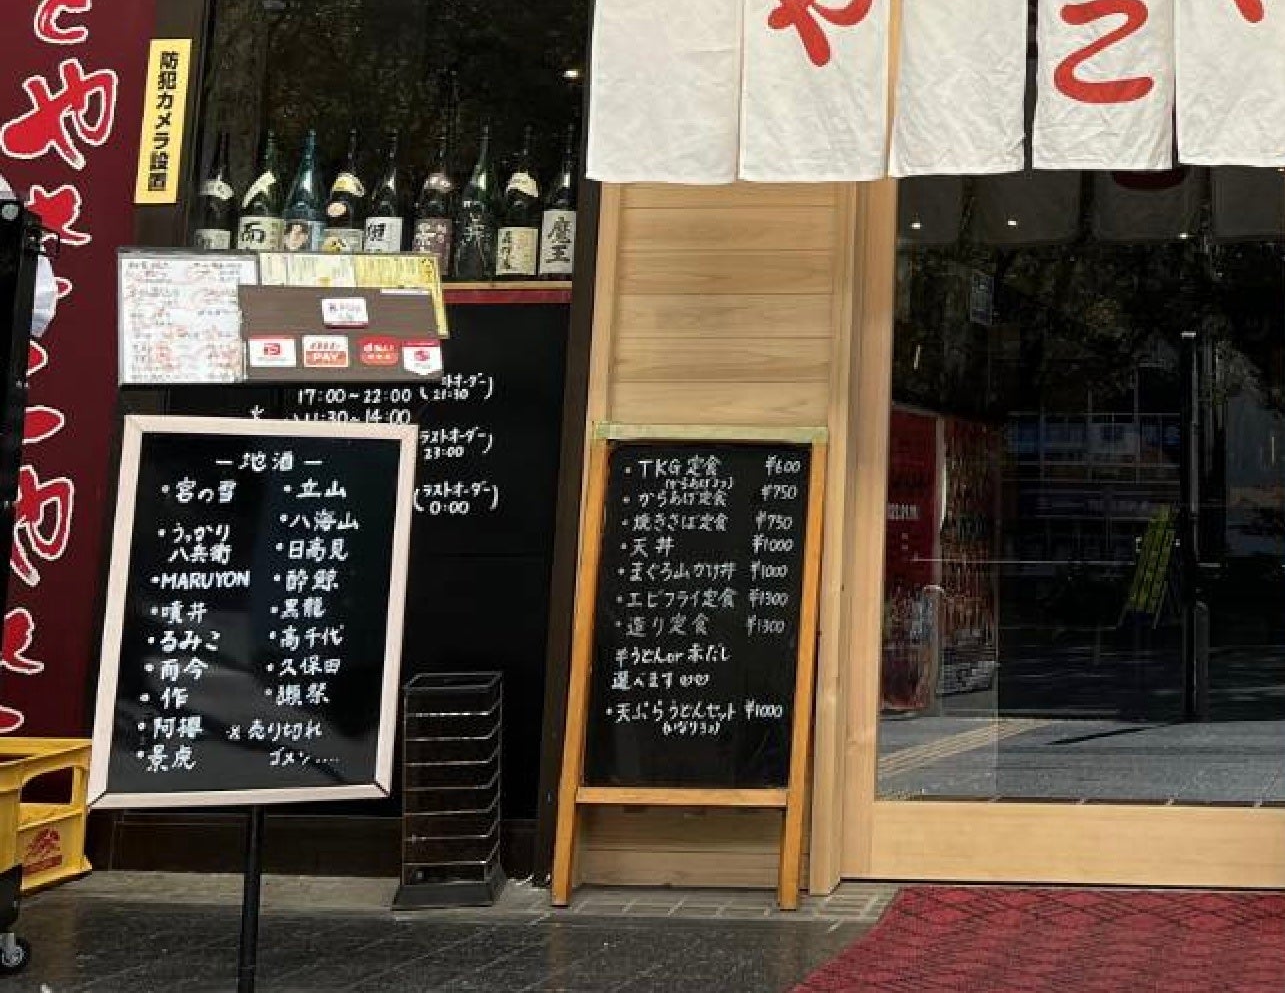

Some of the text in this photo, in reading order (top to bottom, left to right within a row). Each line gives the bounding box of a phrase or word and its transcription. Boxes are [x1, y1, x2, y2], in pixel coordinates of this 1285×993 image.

[147, 50, 180, 193] 防犯カメラ設置
[296, 478, 347, 499] 立山
[289, 508, 360, 531] 八海山
[287, 539, 349, 562] 日高見
[160, 571, 251, 589] MARUYON
[625, 586, 739, 608] エビフライ定食
[160, 631, 221, 652] るみこ
[279, 625, 344, 651] 高千代
[279, 658, 341, 676] 久保田
[160, 686, 188, 709] 作
[147, 744, 196, 772] 景虎
